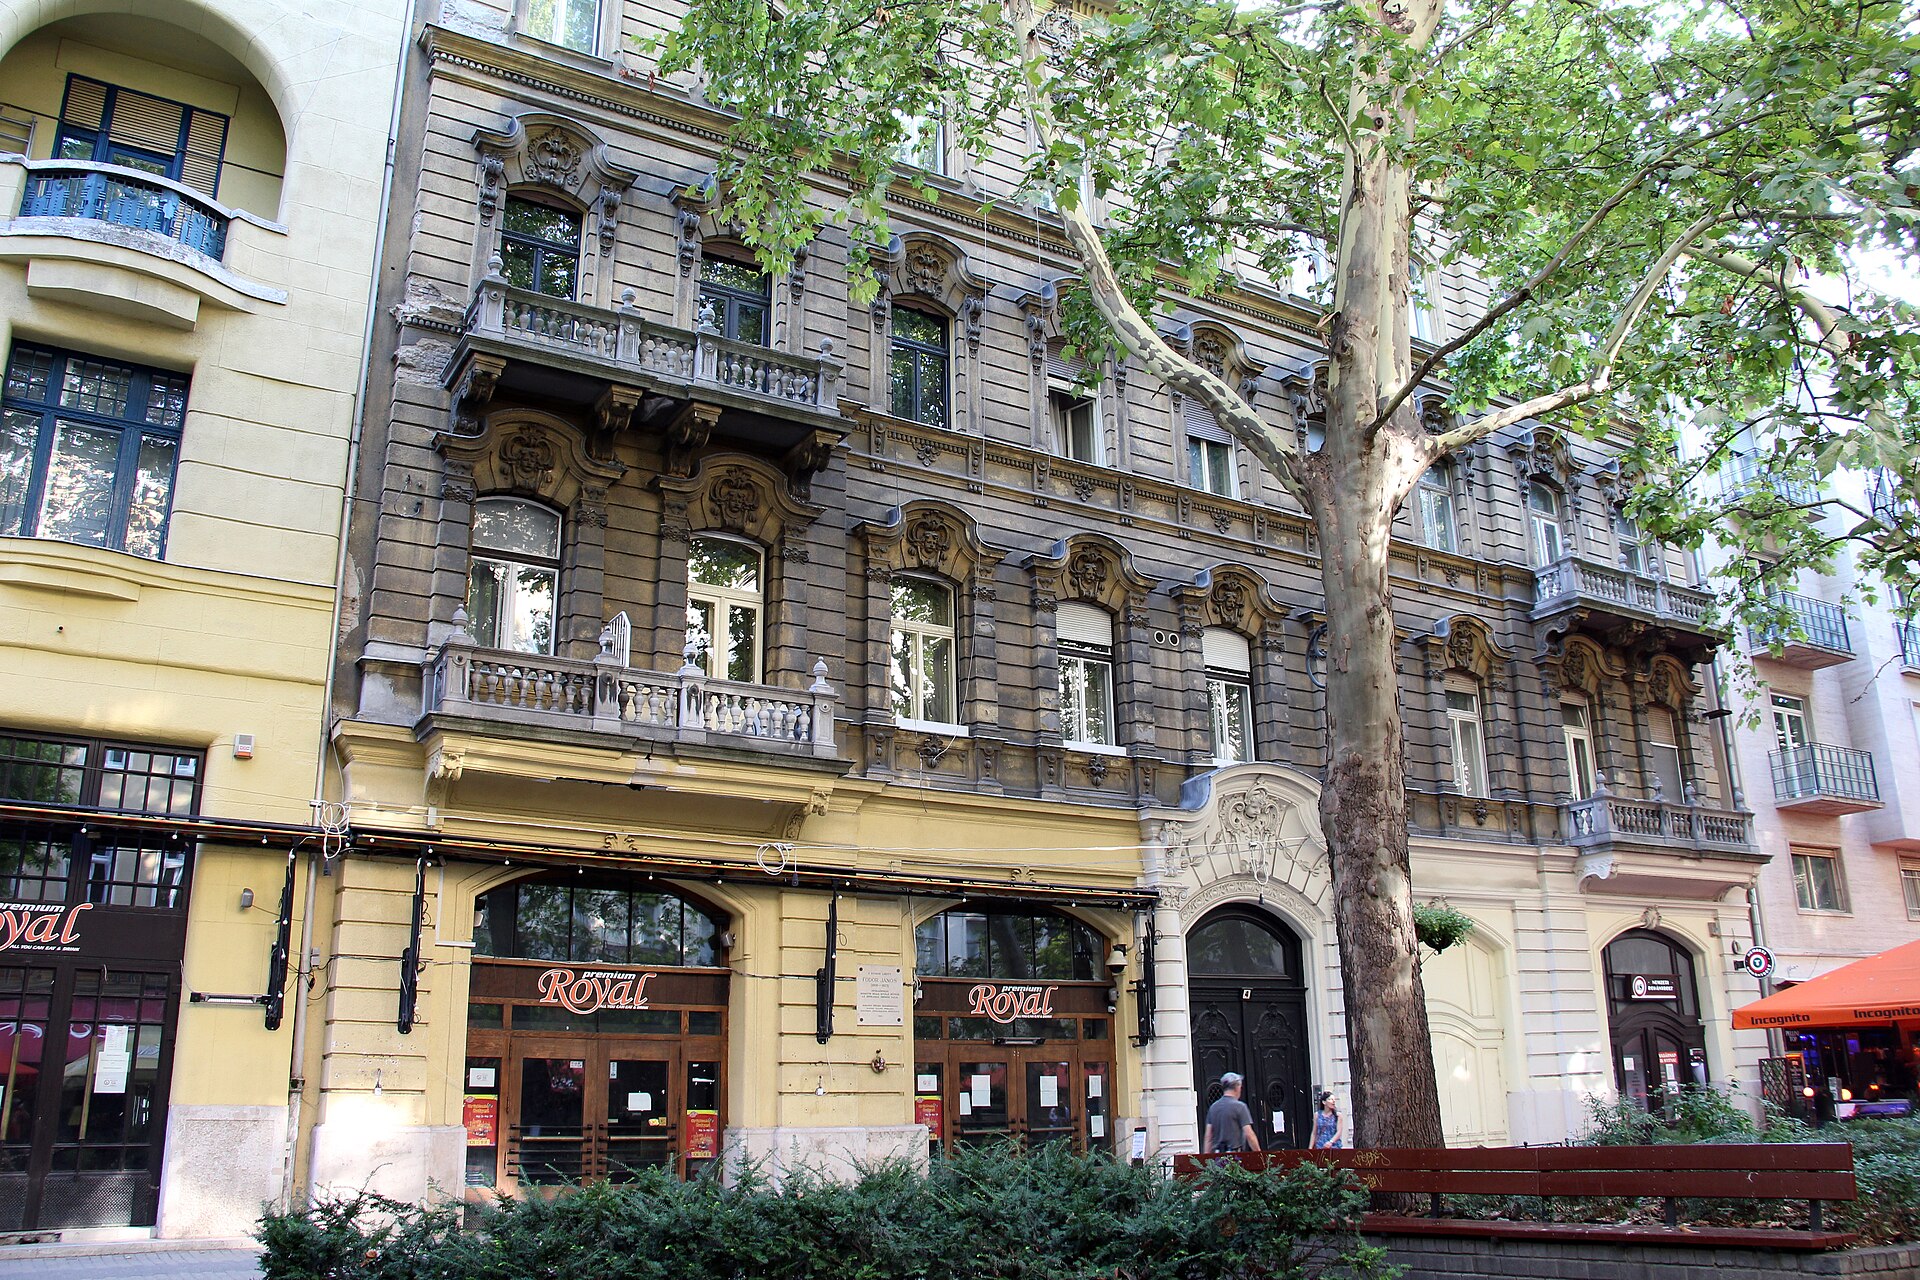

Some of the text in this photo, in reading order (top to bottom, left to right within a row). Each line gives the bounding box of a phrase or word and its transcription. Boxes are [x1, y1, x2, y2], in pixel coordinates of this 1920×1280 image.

[0, 902, 66, 913] remium
[0, 903, 93, 952] yal
[582, 971, 637, 980] premium
[538, 968, 657, 1015] Royal
[1001, 985, 1043, 993] premium
[968, 984, 1058, 1024] Royal
[1854, 1006, 1920, 1019] Incognito
[1751, 1014, 1810, 1026] Incognito
